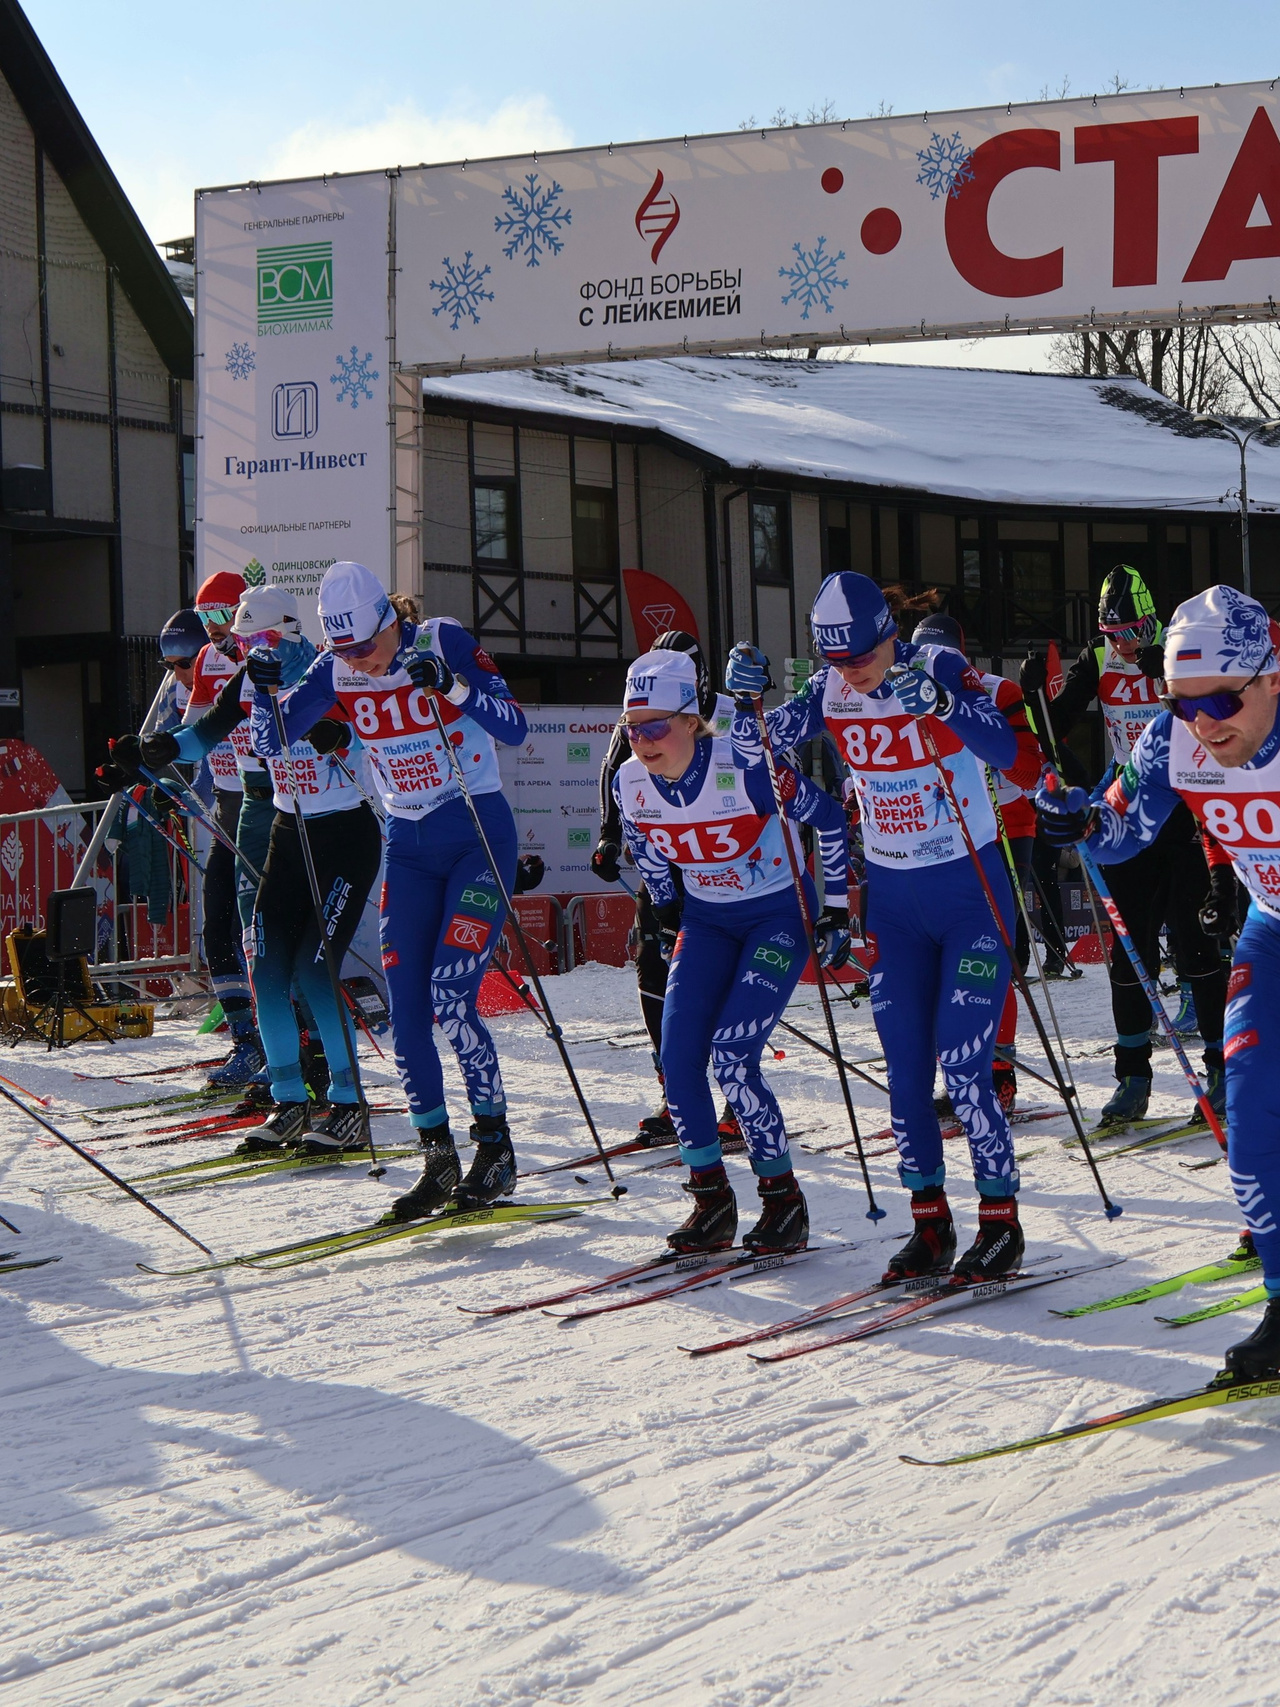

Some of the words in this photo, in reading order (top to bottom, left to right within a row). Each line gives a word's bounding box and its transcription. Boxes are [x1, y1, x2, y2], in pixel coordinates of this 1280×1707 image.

[244, 216, 300, 231] ГЕНЕРАЛЬНЫЕ
[302, 212, 345, 226] ПАРТНЕРЫ
[580, 277, 644, 302] ФОНД
[650, 268, 742, 295] БОРЬБЫ
[579, 306, 593, 327] С
[602, 289, 741, 325] ЛЕЙКЕМИЕЙ
[258, 319, 333, 337] БИОХИММАК
[224, 451, 368, 480] Гарант-Инвест
[240, 523, 307, 534] ОФИЦИАЛЬНЫЕ
[309, 520, 351, 531] ПАРТНЕРЫ
[272, 575, 295, 584] ПАРК
[323, 611, 353, 632] RWT
[815, 625, 851, 644] RWT
[253, 650, 269, 661] OXA
[893, 671, 915, 687] COXA
[354, 688, 440, 735] 810
[530, 723, 566, 733] ЖНЯ
[382, 740, 431, 755] ЛЫЖНЯ
[842, 720, 926, 766] 821
[388, 752, 435, 768] САМОЕ
[275, 770, 317, 781] ВРМЯ
[391, 763, 439, 780] ВРЕМЯ
[1197, 771, 1225, 779] БОРЬБЫ
[278, 783, 319, 795] ЖТЬ
[395, 775, 442, 793] ЖИТЬ
[559, 778, 599, 787] samolet
[869, 778, 918, 792] ЛЫЖНЯ
[873, 792, 921, 808] САМОЕ
[875, 805, 925, 821] ВРЕМЯ
[876, 820, 928, 835] ЖИТЬ
[650, 824, 740, 861] 813
[871, 846, 908, 860] КОМАНДА
[323, 876, 344, 920] PRO
[460, 889, 499, 912] BCM
[256, 911, 266, 958] PRO
[753, 947, 791, 972] BCM
[958, 958, 997, 979] BCM
[757, 977, 779, 993] COXA
[968, 995, 991, 1005] COXA
[243, 1150, 286, 1162] FISCHER
[300, 1154, 344, 1166] FISCHER
[483, 1149, 511, 1188] SPINE
[451, 1210, 495, 1226] FISCHER
[980, 1231, 1012, 1267] MADSHUS
[675, 1256, 709, 1270] MADSHUS
[753, 1257, 785, 1271] MADSHUS
[905, 1277, 940, 1292] MADSHUS
[972, 1283, 1008, 1298] MADSHUS
